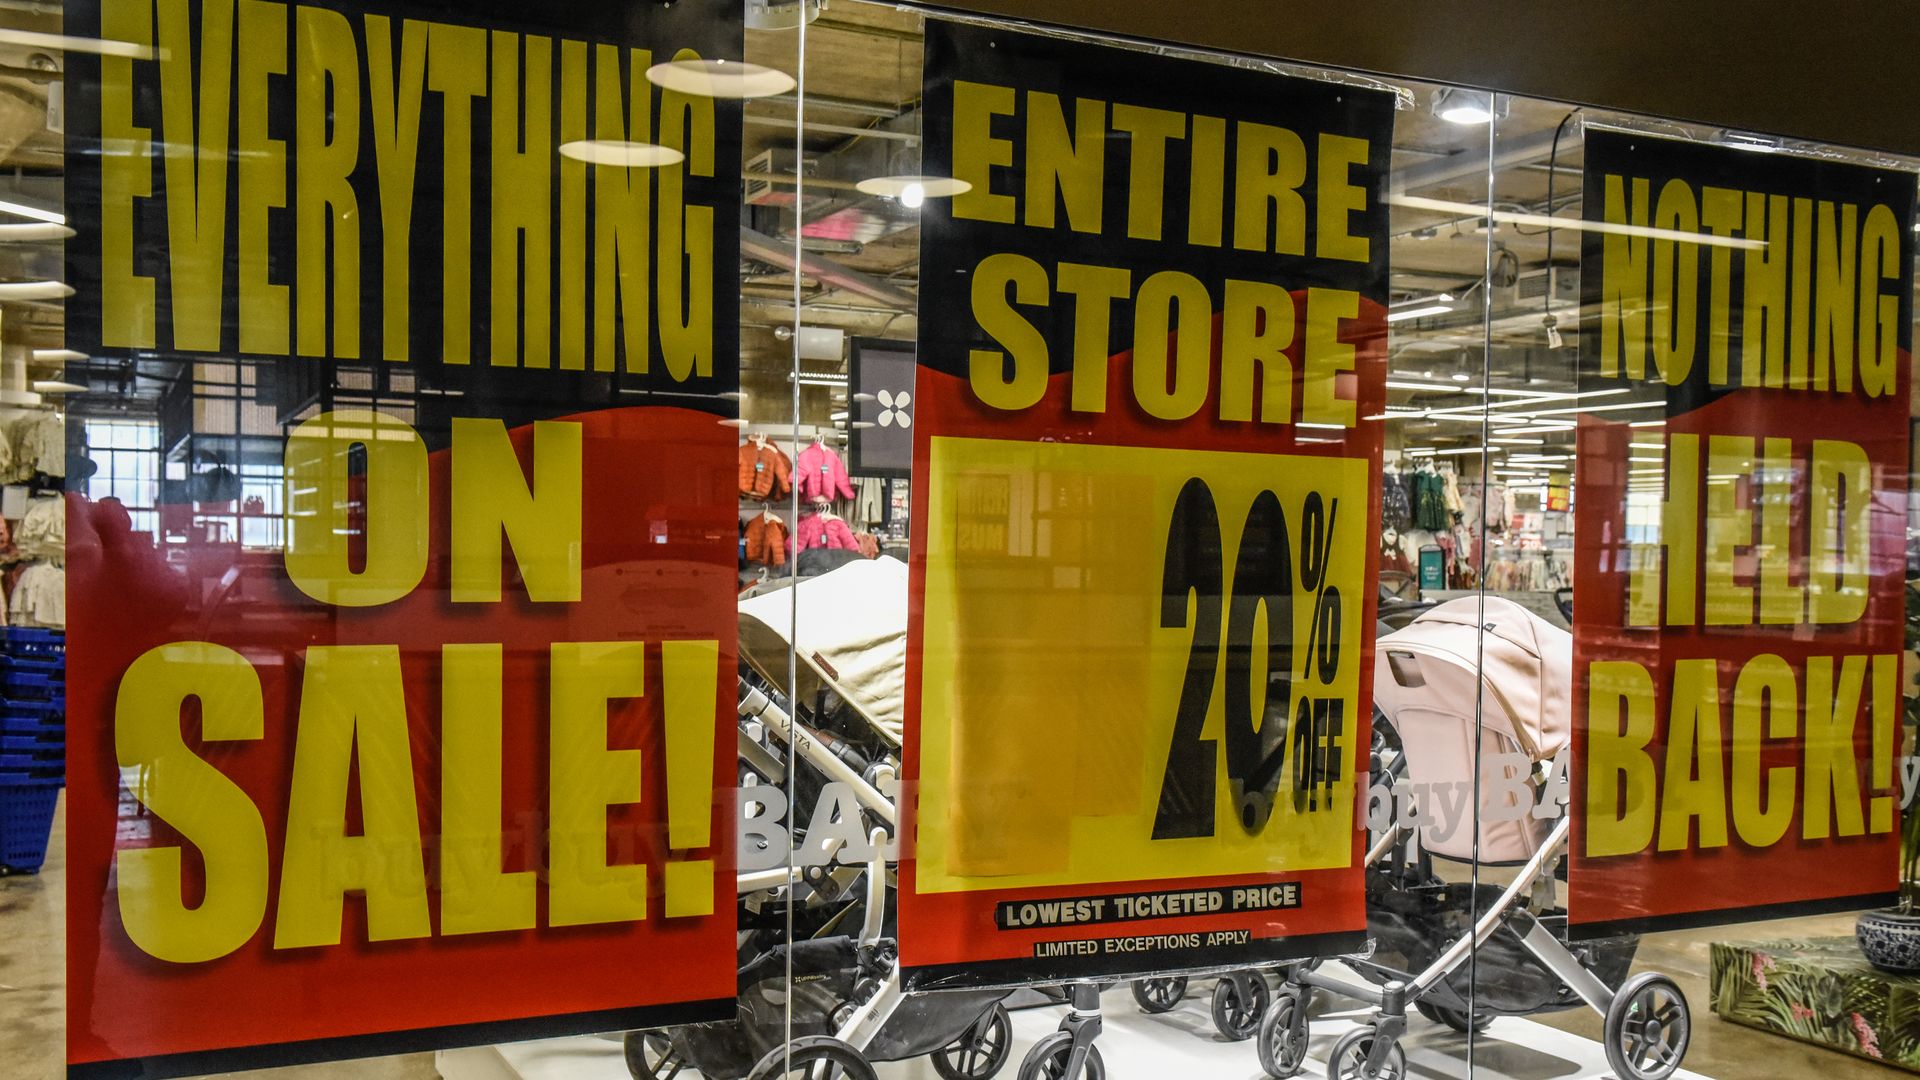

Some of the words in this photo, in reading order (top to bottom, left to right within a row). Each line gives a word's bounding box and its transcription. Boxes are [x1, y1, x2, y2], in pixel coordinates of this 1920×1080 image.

[101, 0, 714, 382] EVERYTHING
[952, 80, 1370, 263] ENTIRE
[969, 253, 1360, 428] STORE
[1600, 174, 1900, 398] NOTHING
[284, 409, 583, 607] ON
[1628, 432, 1872, 626] HELD
[114, 640, 719, 963] SALE!
[1293, 695, 1344, 815] OFF
[1586, 654, 1898, 858] BACK!
[1006, 901, 1105, 926] LOWEST
[1114, 891, 1222, 918] TICKETED
[1232, 885, 1297, 910] PRICE
[1036, 940, 1098, 957] LIMITED
[1105, 933, 1200, 953] EXCEPTIONS
[1206, 930, 1249, 946] APPLY
